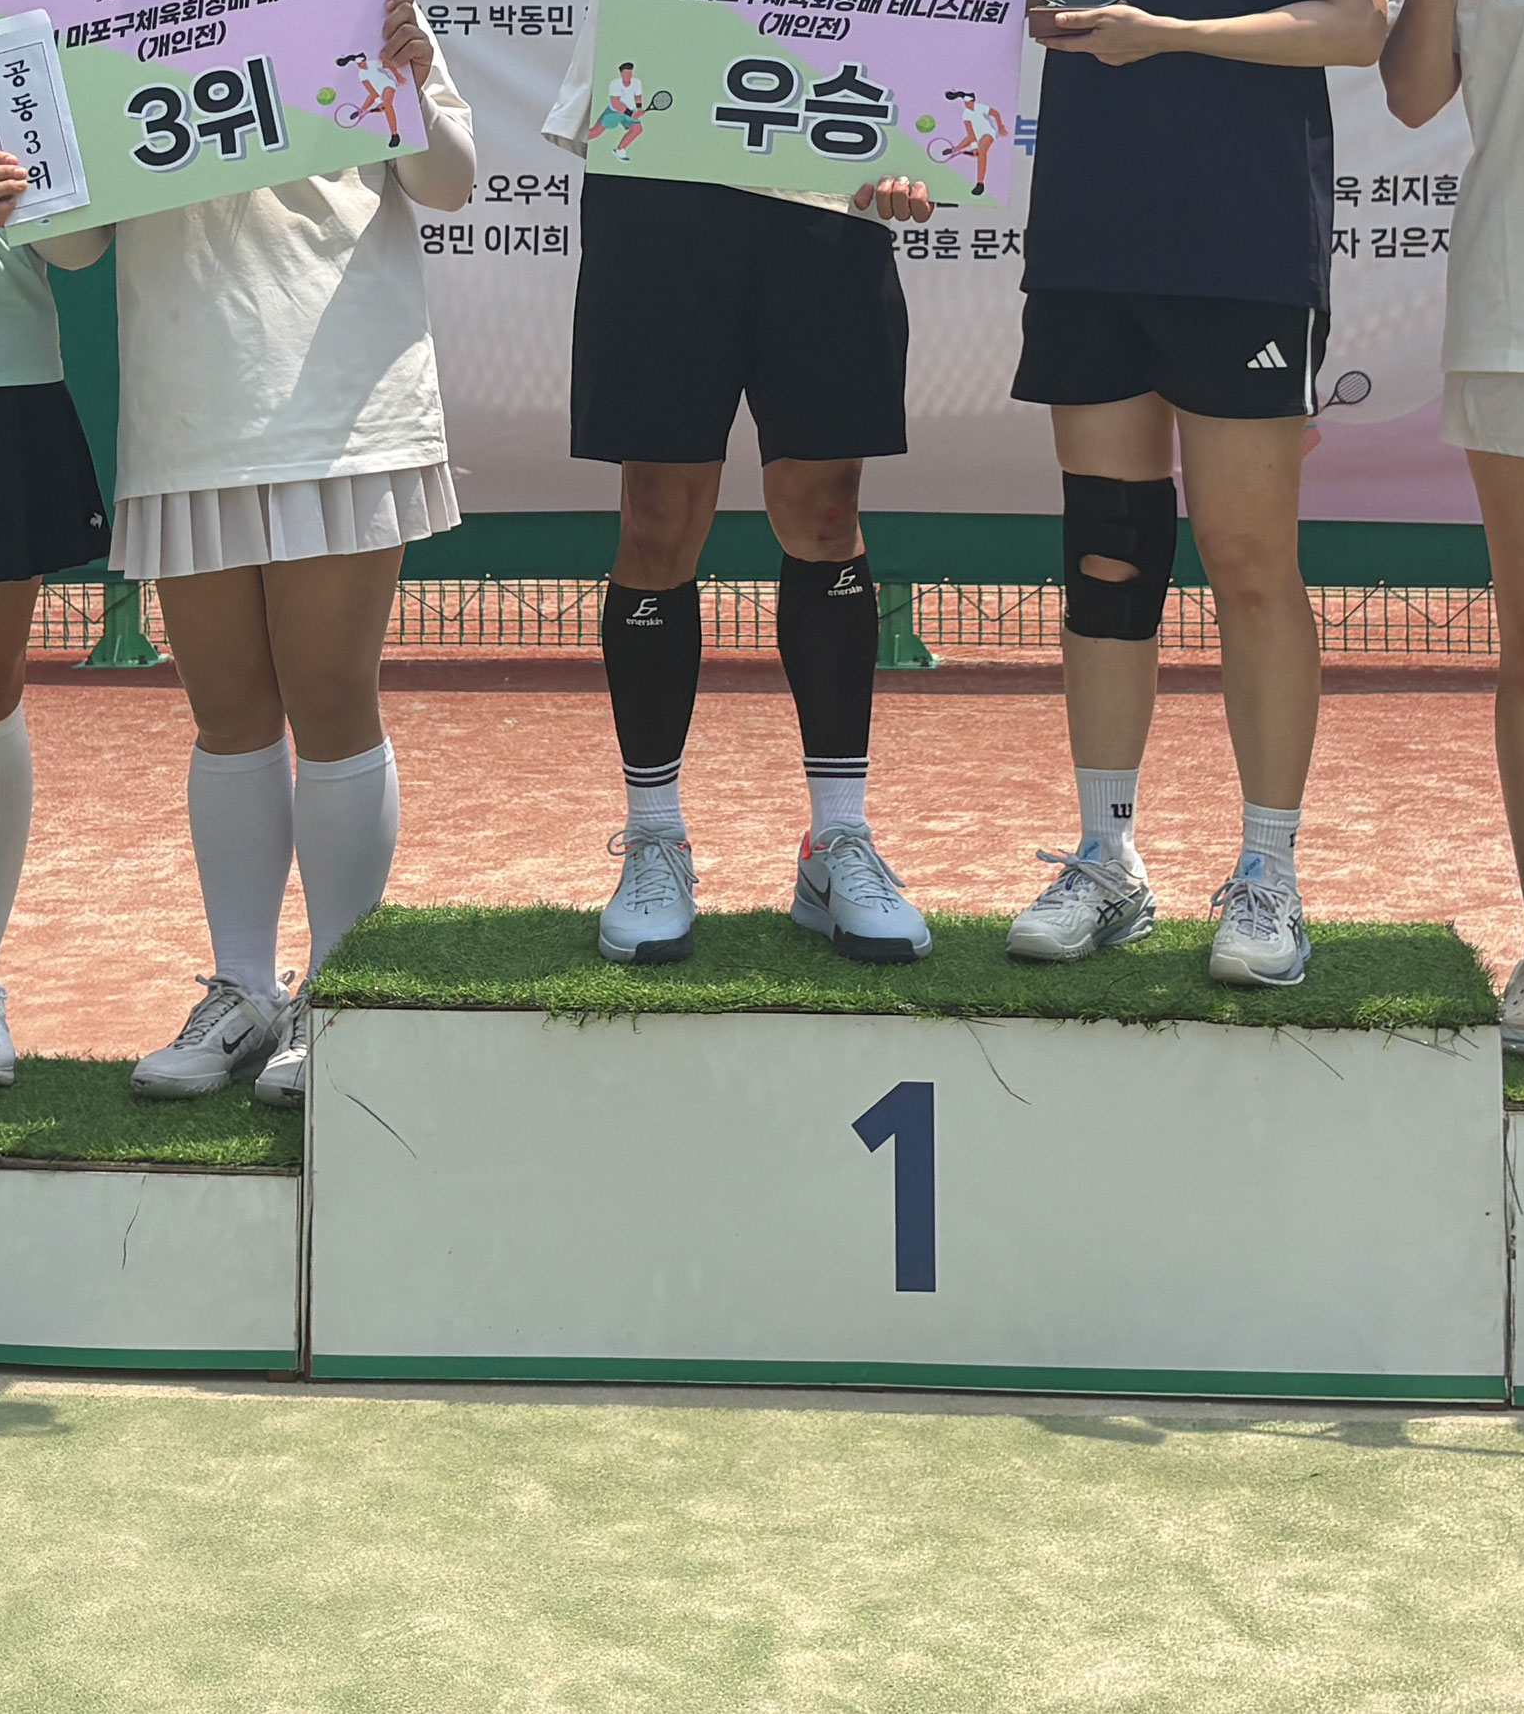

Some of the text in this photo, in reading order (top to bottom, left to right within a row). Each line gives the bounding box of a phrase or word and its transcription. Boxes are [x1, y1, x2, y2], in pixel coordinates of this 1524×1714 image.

[488, 4, 574, 37] 박동민
[758, 10, 851, 42] (개인전)
[136, 20, 228, 63] (개인전)
[125, 56, 283, 169] 3위
[712, 56, 893, 158] 우승
[484, 174, 570, 206] 오우석
[1370, 173, 1459, 207] 최지훈
[483, 223, 569, 257] 이지희
[625, 617, 664, 627] enerskin
[851, 1081, 936, 1292] 1
